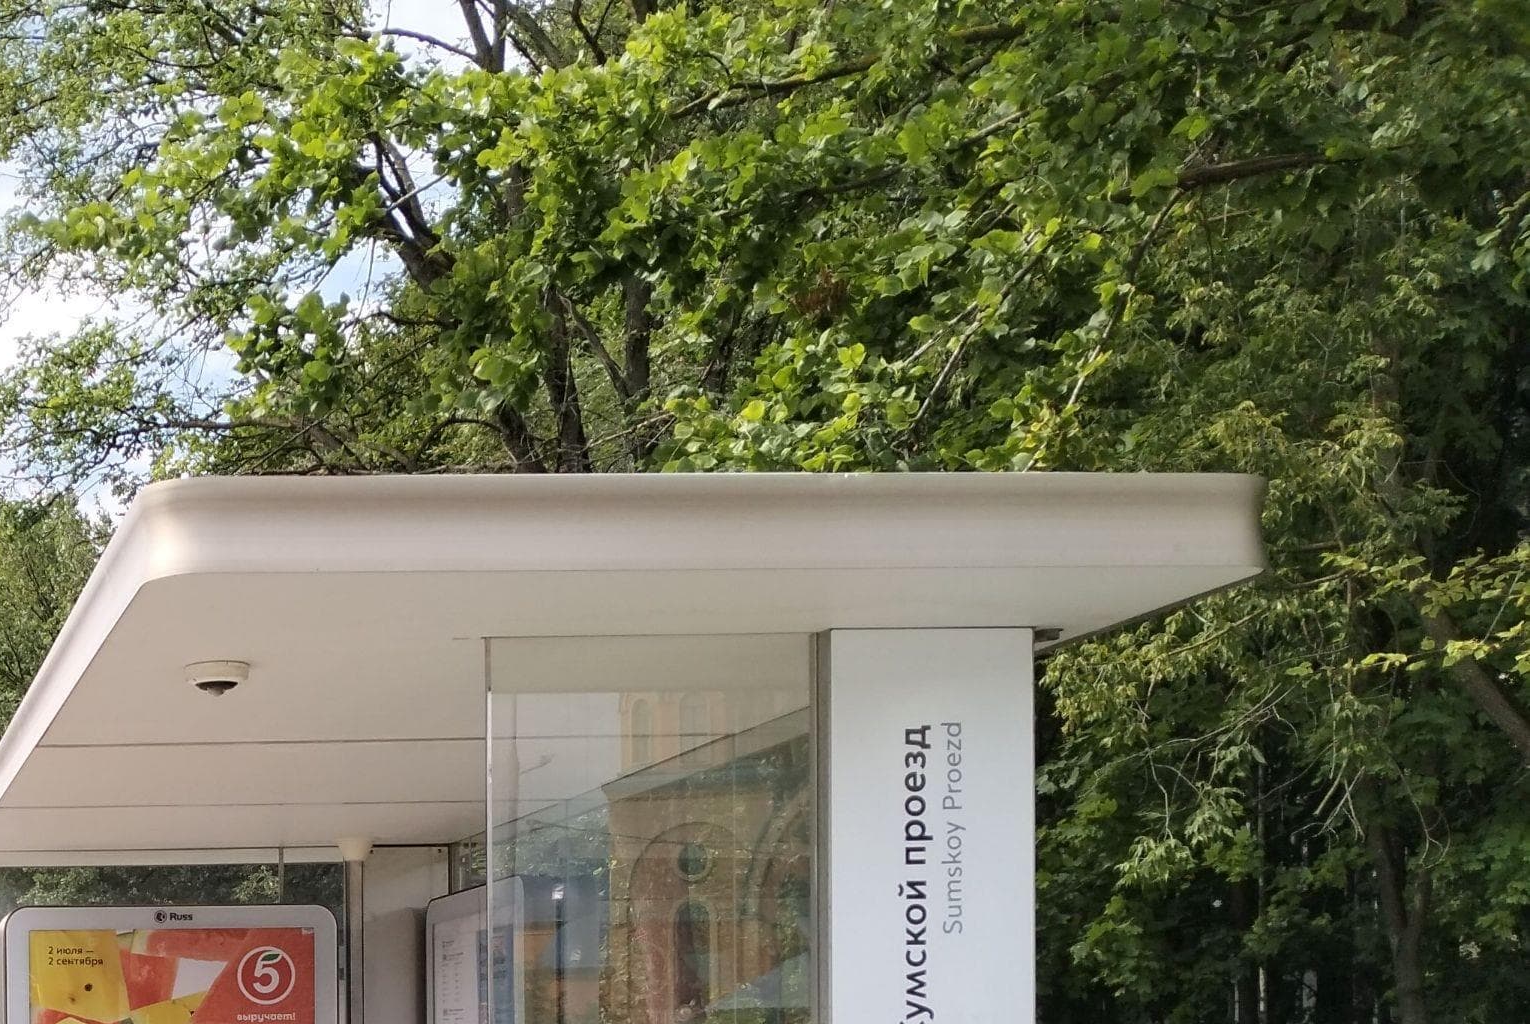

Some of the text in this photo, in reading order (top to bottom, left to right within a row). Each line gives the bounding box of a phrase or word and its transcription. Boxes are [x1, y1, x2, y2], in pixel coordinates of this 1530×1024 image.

[905, 724, 933, 865] проезд
[940, 722, 966, 934] Sumskoy Proezd
[169, 912, 193, 921] Russ
[48, 946, 54, 955] 2
[56, 947, 83, 956] июля
[48, 957, 104, 967] 2 сентября
[253, 950, 287, 994] 5
[237, 1012, 296, 1022] выручает!
